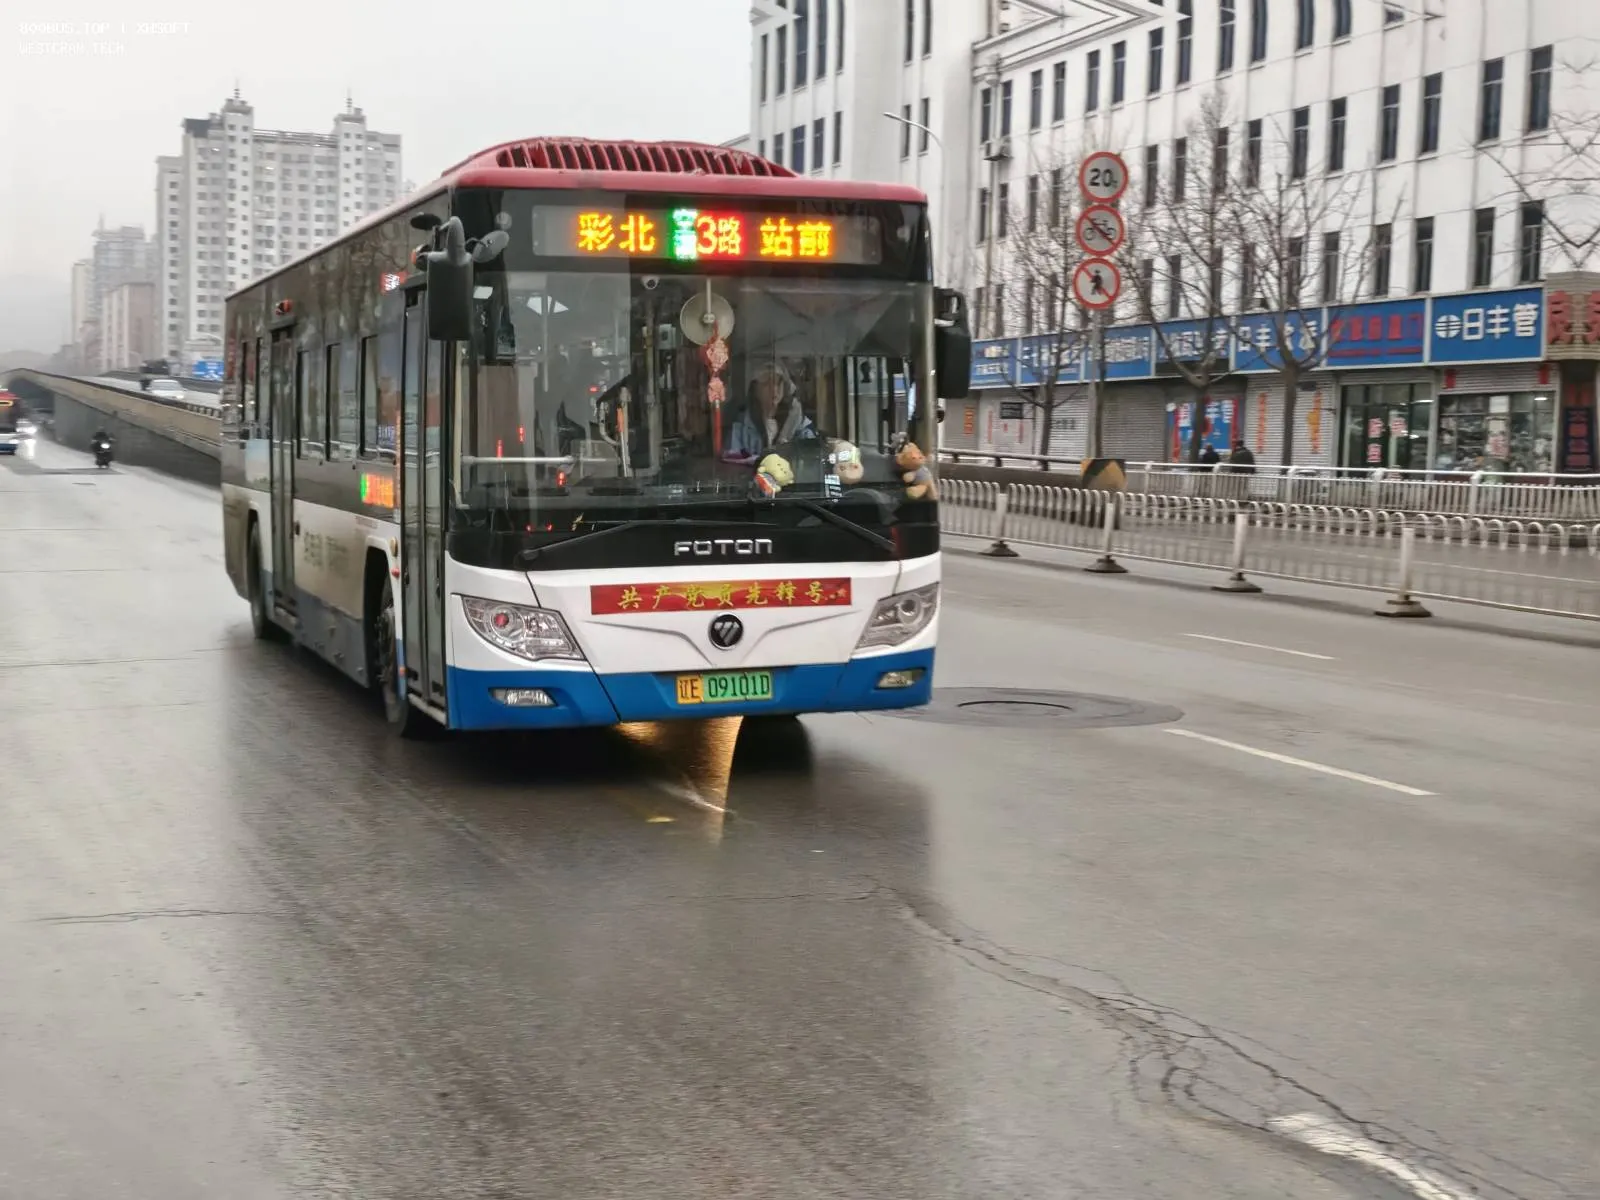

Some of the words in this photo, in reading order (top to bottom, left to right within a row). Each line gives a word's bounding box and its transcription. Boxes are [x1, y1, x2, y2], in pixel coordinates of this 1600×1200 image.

[1088, 168, 1114, 188] 20
[577, 212, 657, 252] 彩北
[759, 217, 833, 256] 站前
[1463, 302, 1539, 341] 日丰管
[673, 538, 773, 556] FOTON
[617, 580, 826, 610] 共产党员先锋号
[708, 675, 771, 698] 09101D
